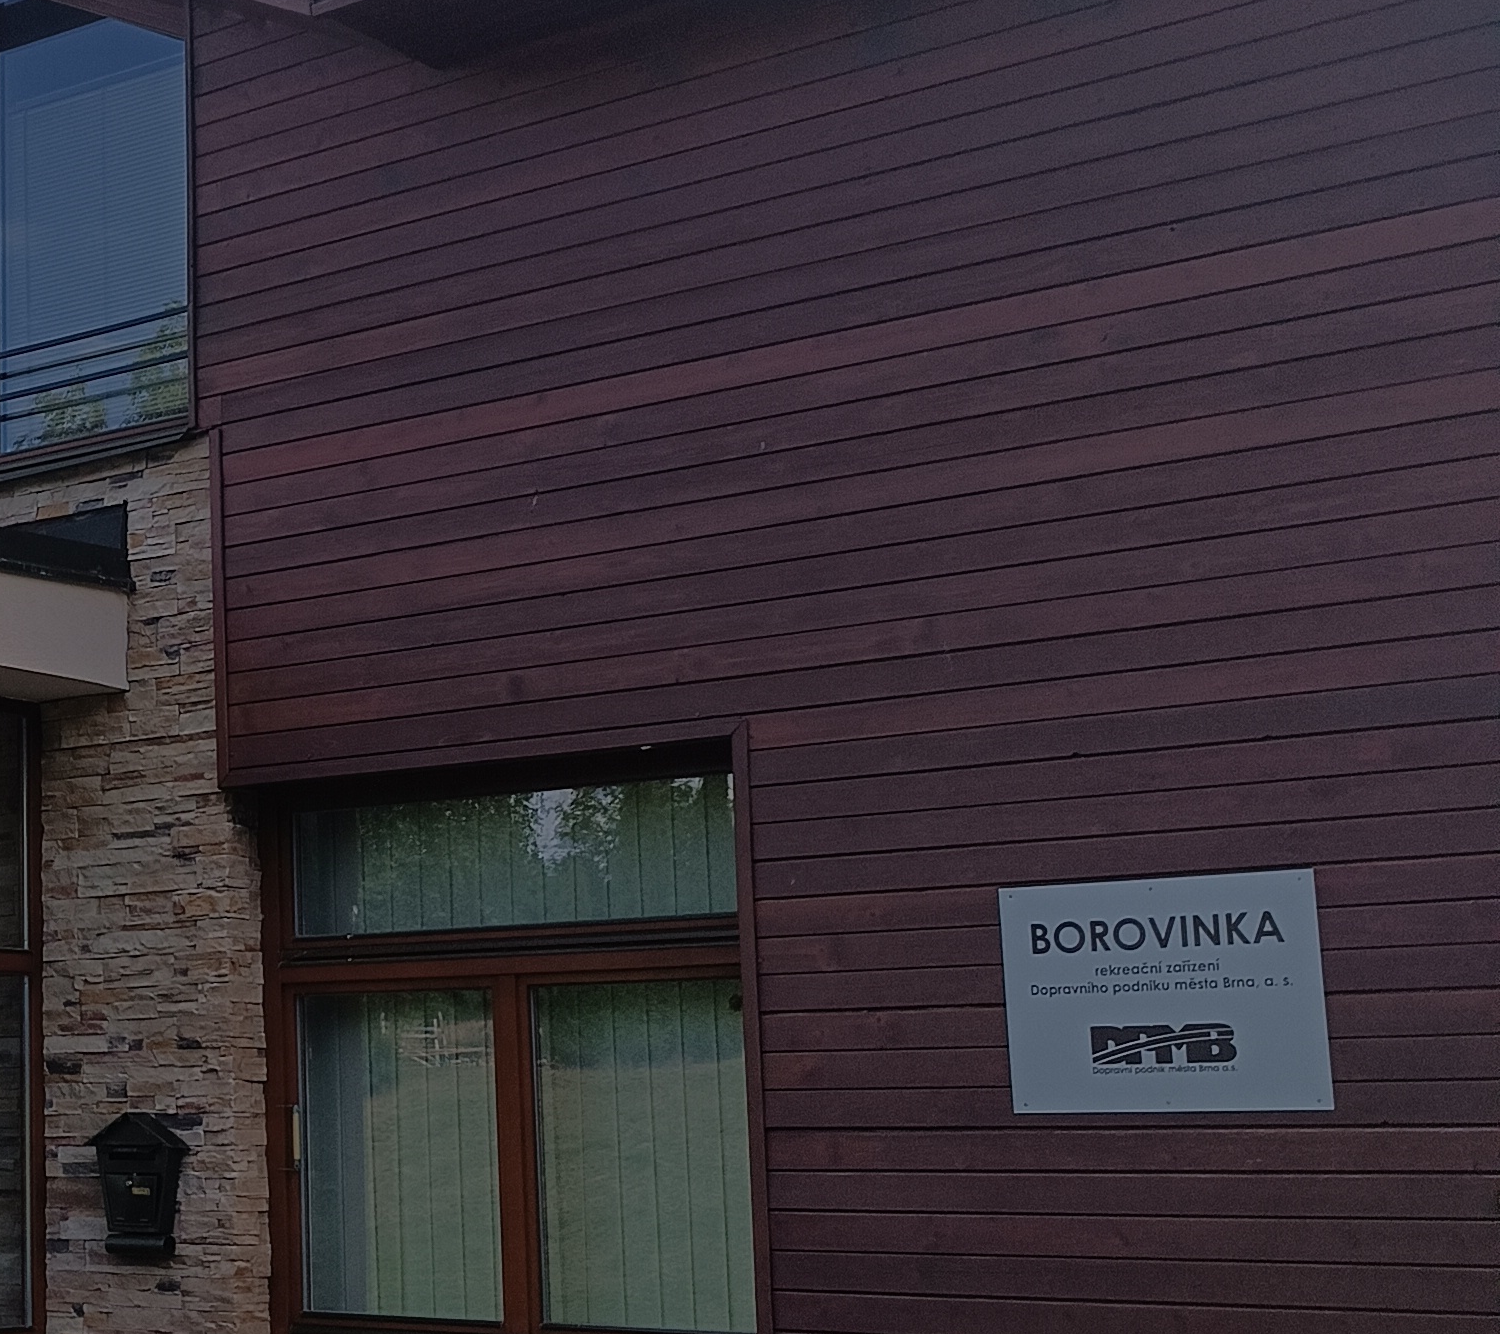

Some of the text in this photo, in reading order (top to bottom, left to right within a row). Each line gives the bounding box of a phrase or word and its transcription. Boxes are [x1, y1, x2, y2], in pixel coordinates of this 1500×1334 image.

[1030, 910, 1285, 955] BOROVINKA
[1094, 957, 1220, 977] rekreační zařízení
[1030, 980, 1109, 998] Dopravního
[1113, 979, 1170, 996] podniku
[1174, 977, 1218, 991] města
[1222, 976, 1260, 989] Brna,
[1090, 1022, 1238, 1065] DPMB
[1092, 1066, 1132, 1075] Dopravní
[1134, 1065, 1165, 1075] podnik
